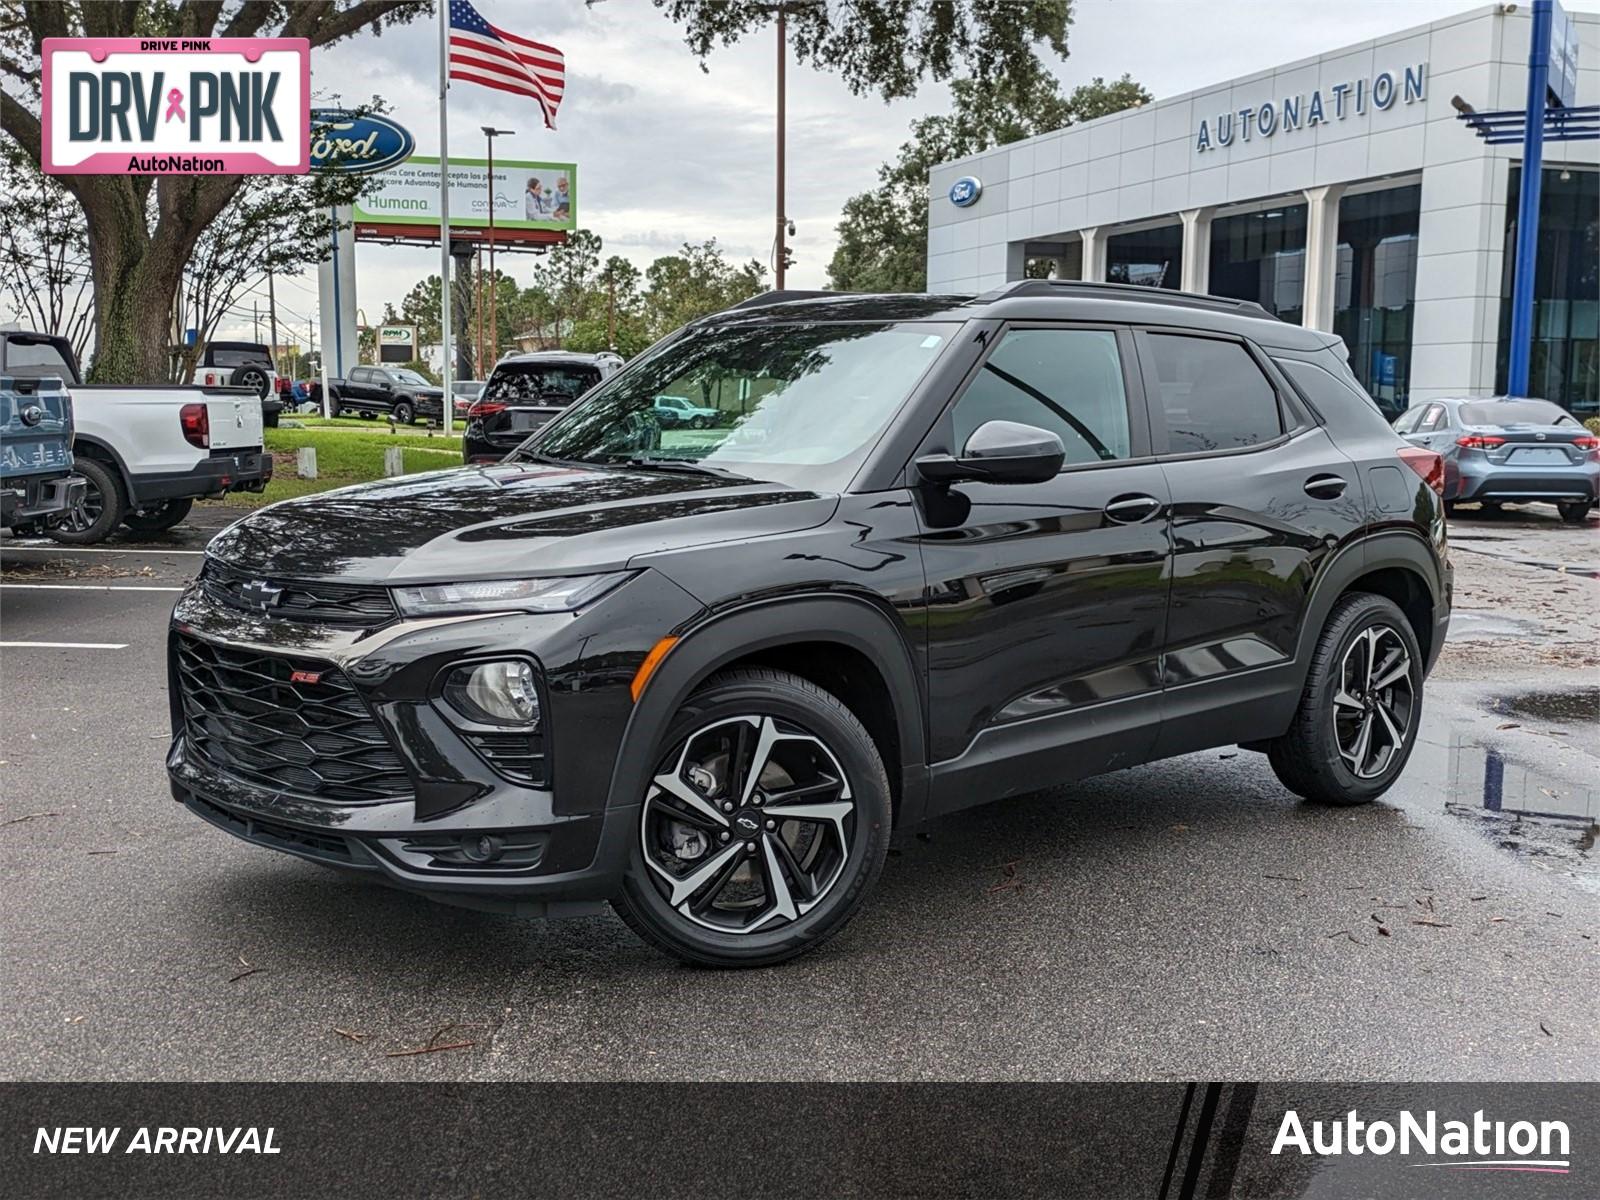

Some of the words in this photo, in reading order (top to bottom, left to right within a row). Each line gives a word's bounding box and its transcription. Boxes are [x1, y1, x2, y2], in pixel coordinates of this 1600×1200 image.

[1197, 63, 1426, 152] AUTONATION
[417, 170, 441, 178] Center
[447, 172, 469, 181] cepta
[470, 172, 481, 180] los
[482, 173, 507, 181] pnes
[404, 178, 441, 189] Advantag
[457, 181, 488, 189] Humana
[368, 195, 428, 210] Humana
[290, 671, 320, 684] RS
